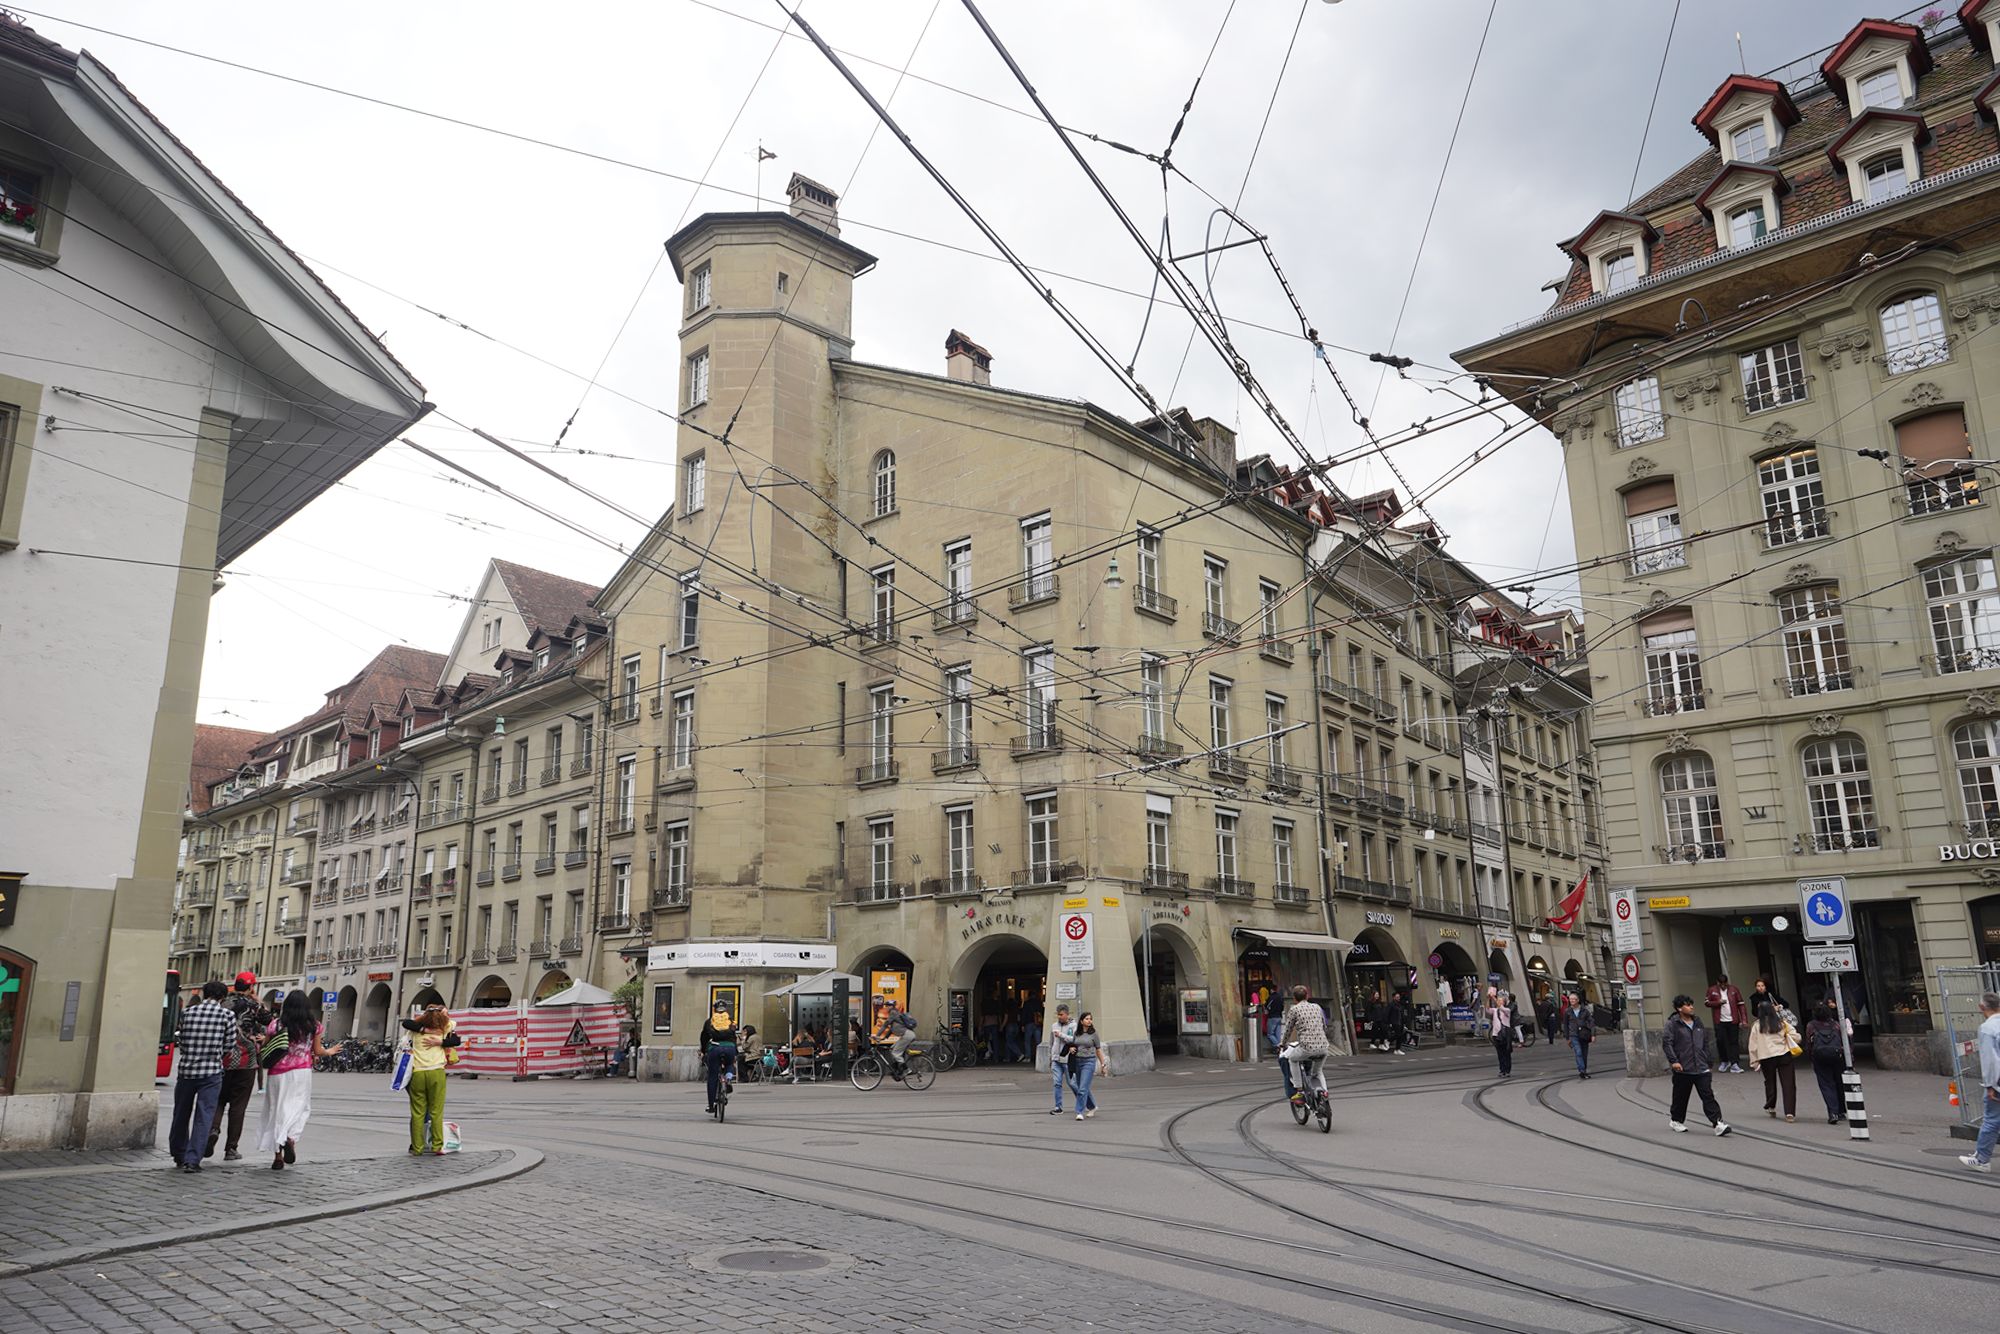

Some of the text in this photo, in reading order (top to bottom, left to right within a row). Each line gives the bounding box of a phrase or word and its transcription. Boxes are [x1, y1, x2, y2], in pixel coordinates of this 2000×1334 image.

[1811, 883, 1831, 891] ZONE
[961, 920, 984, 940] BAR
[985, 915, 992, 927] &
[326, 993, 335, 1002] P
